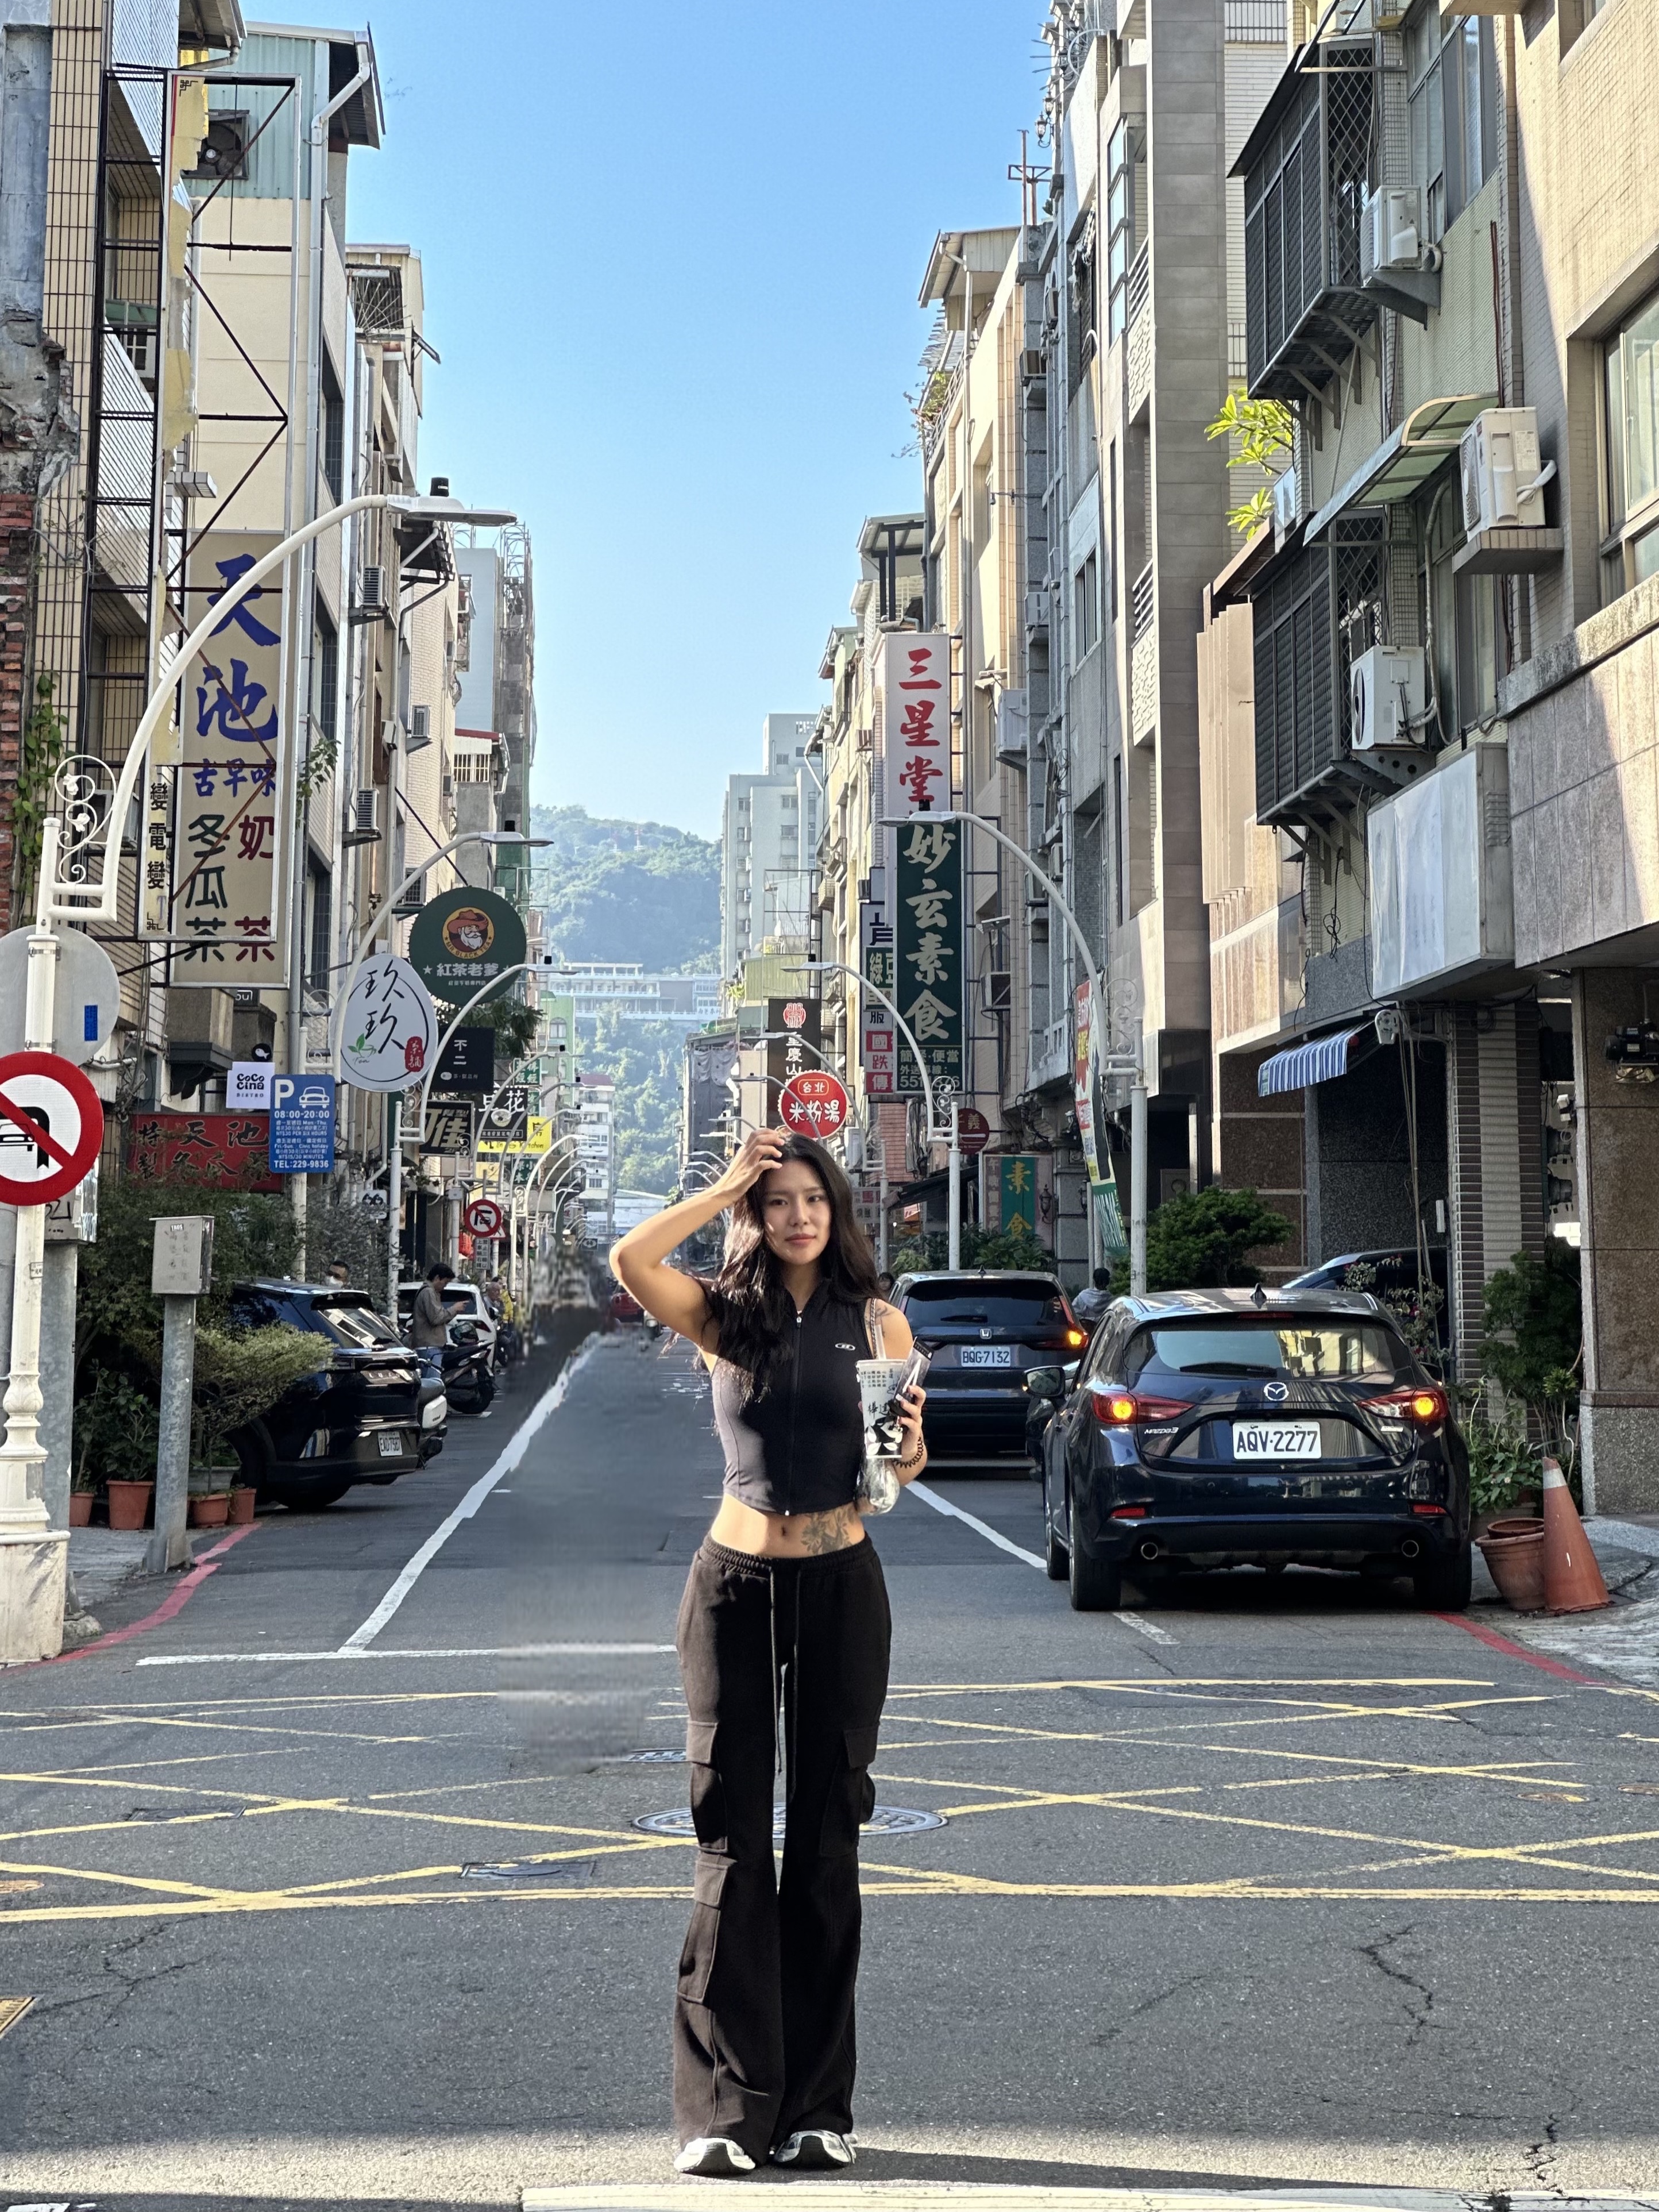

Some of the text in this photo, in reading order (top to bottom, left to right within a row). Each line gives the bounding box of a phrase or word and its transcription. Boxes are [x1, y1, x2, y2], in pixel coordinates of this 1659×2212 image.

[197, 553, 281, 743] 天池
[898, 647, 943, 803] 三星堂
[193, 757, 276, 799] 古早味
[186, 814, 230, 964] 冬瓜茶
[234, 816, 275, 964] 奶茶
[902, 825, 958, 1042] 妙玄素食
[453, 1039, 468, 1065] 不二
[275, 1079, 294, 1109] P
[803, 1081, 825, 1093] 台北
[900, 1076, 960, 1088] 551876
[274, 1110, 330, 1119] 08:00-20:00
[789, 1099, 840, 1124] 米粉湯
[178, 1120, 270, 1148] 天池
[274, 1160, 329, 1169] TEL:229-9836
[1005, 1161, 1032, 1239] 素食
